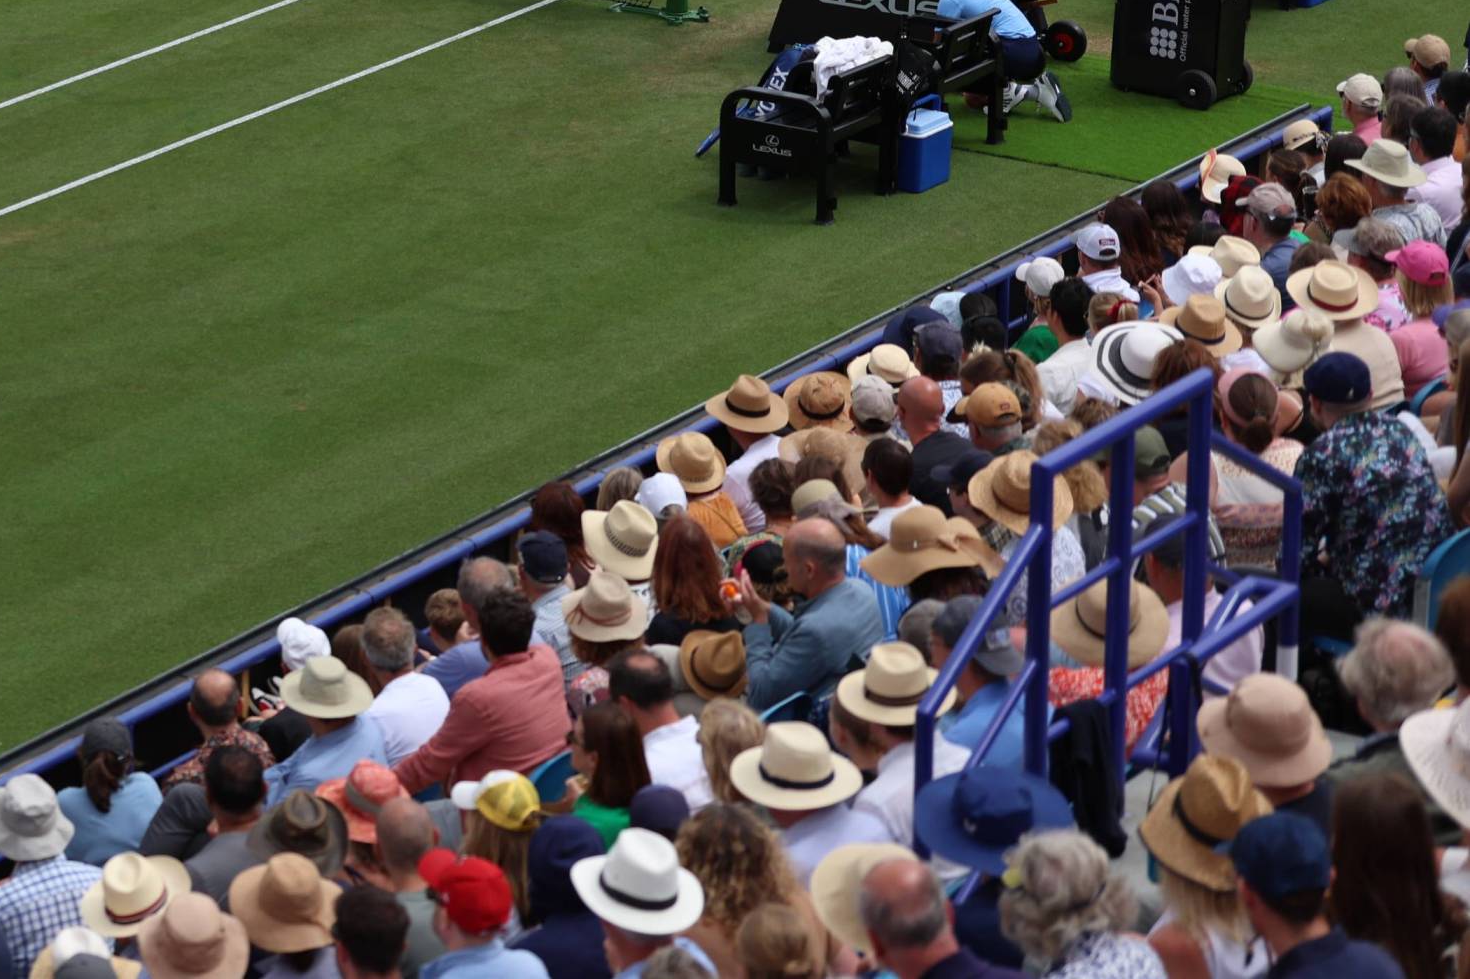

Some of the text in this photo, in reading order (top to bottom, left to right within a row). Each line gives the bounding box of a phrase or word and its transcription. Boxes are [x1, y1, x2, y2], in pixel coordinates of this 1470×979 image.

[1183, 5, 1191, 29] water
[1179, 31, 1188, 62] Official
[754, 66, 790, 117] YOEX
[752, 143, 792, 156] LEXUS
